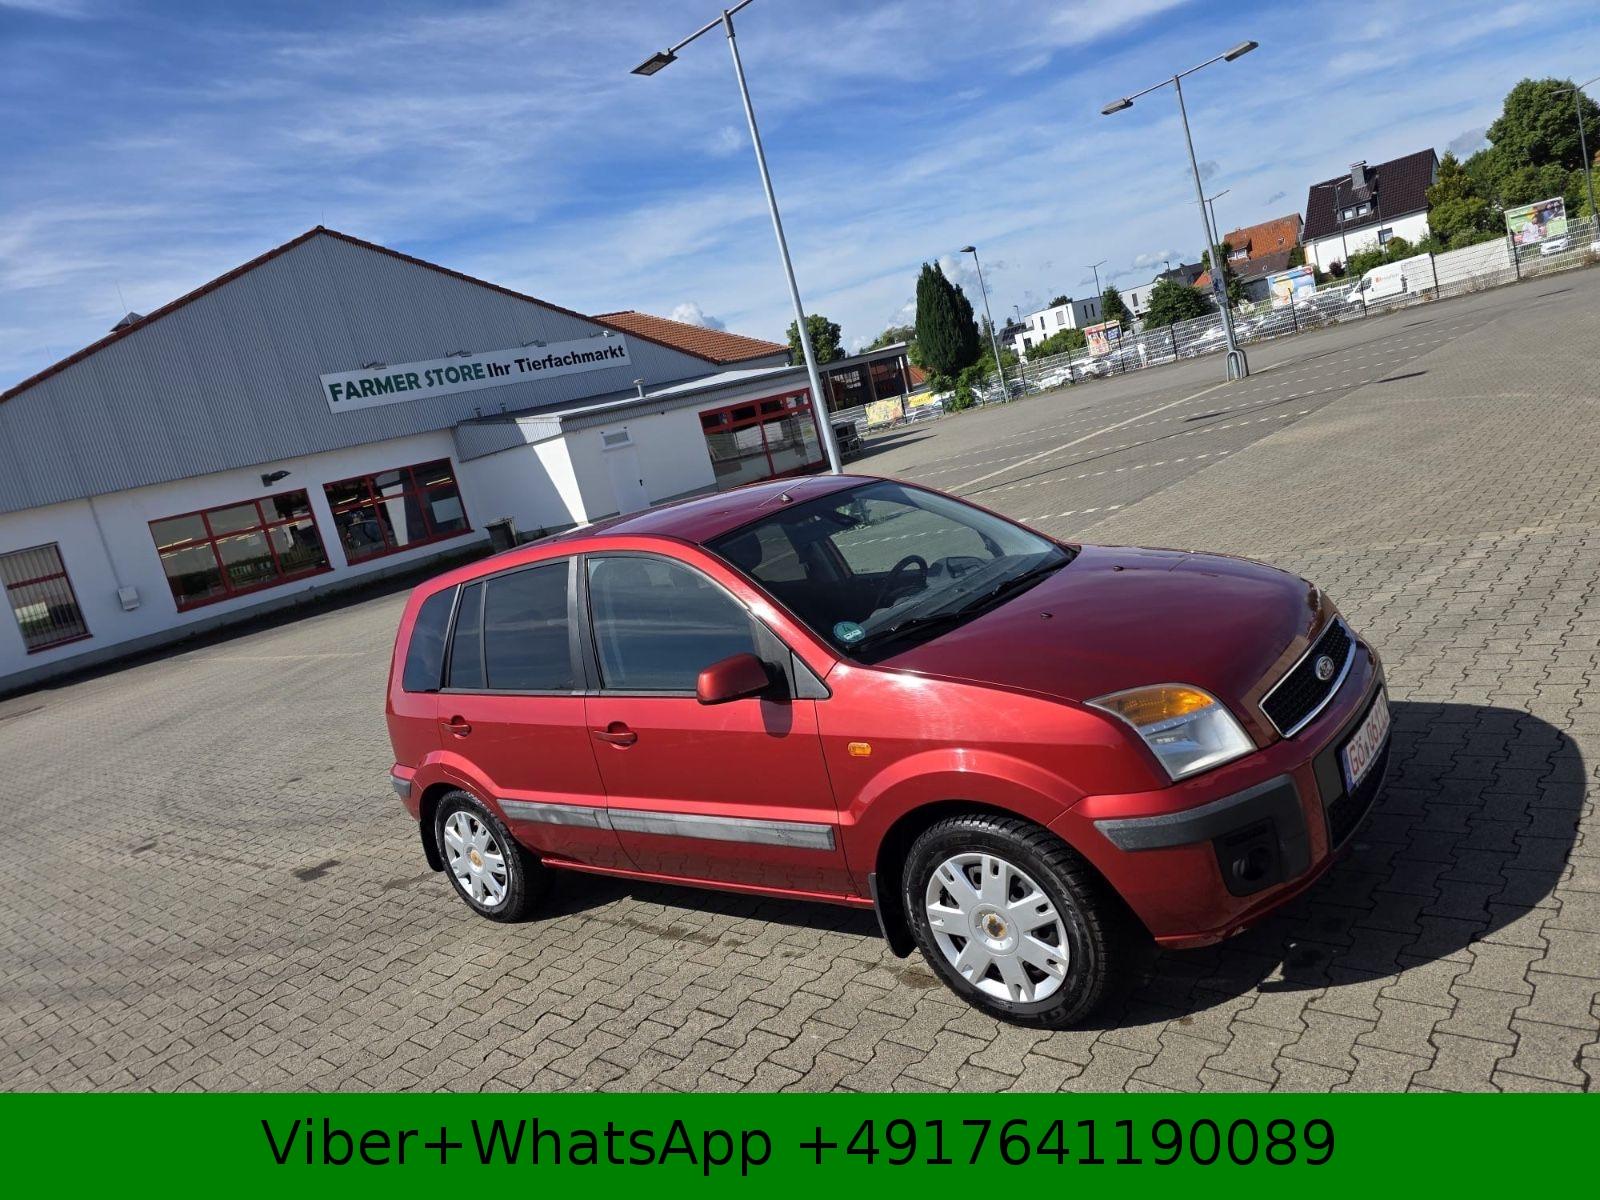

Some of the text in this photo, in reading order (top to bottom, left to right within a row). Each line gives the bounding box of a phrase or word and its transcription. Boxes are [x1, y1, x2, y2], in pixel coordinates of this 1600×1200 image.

[329, 345, 626, 402] FARMER STORE Ihr Tierfachmarkt
